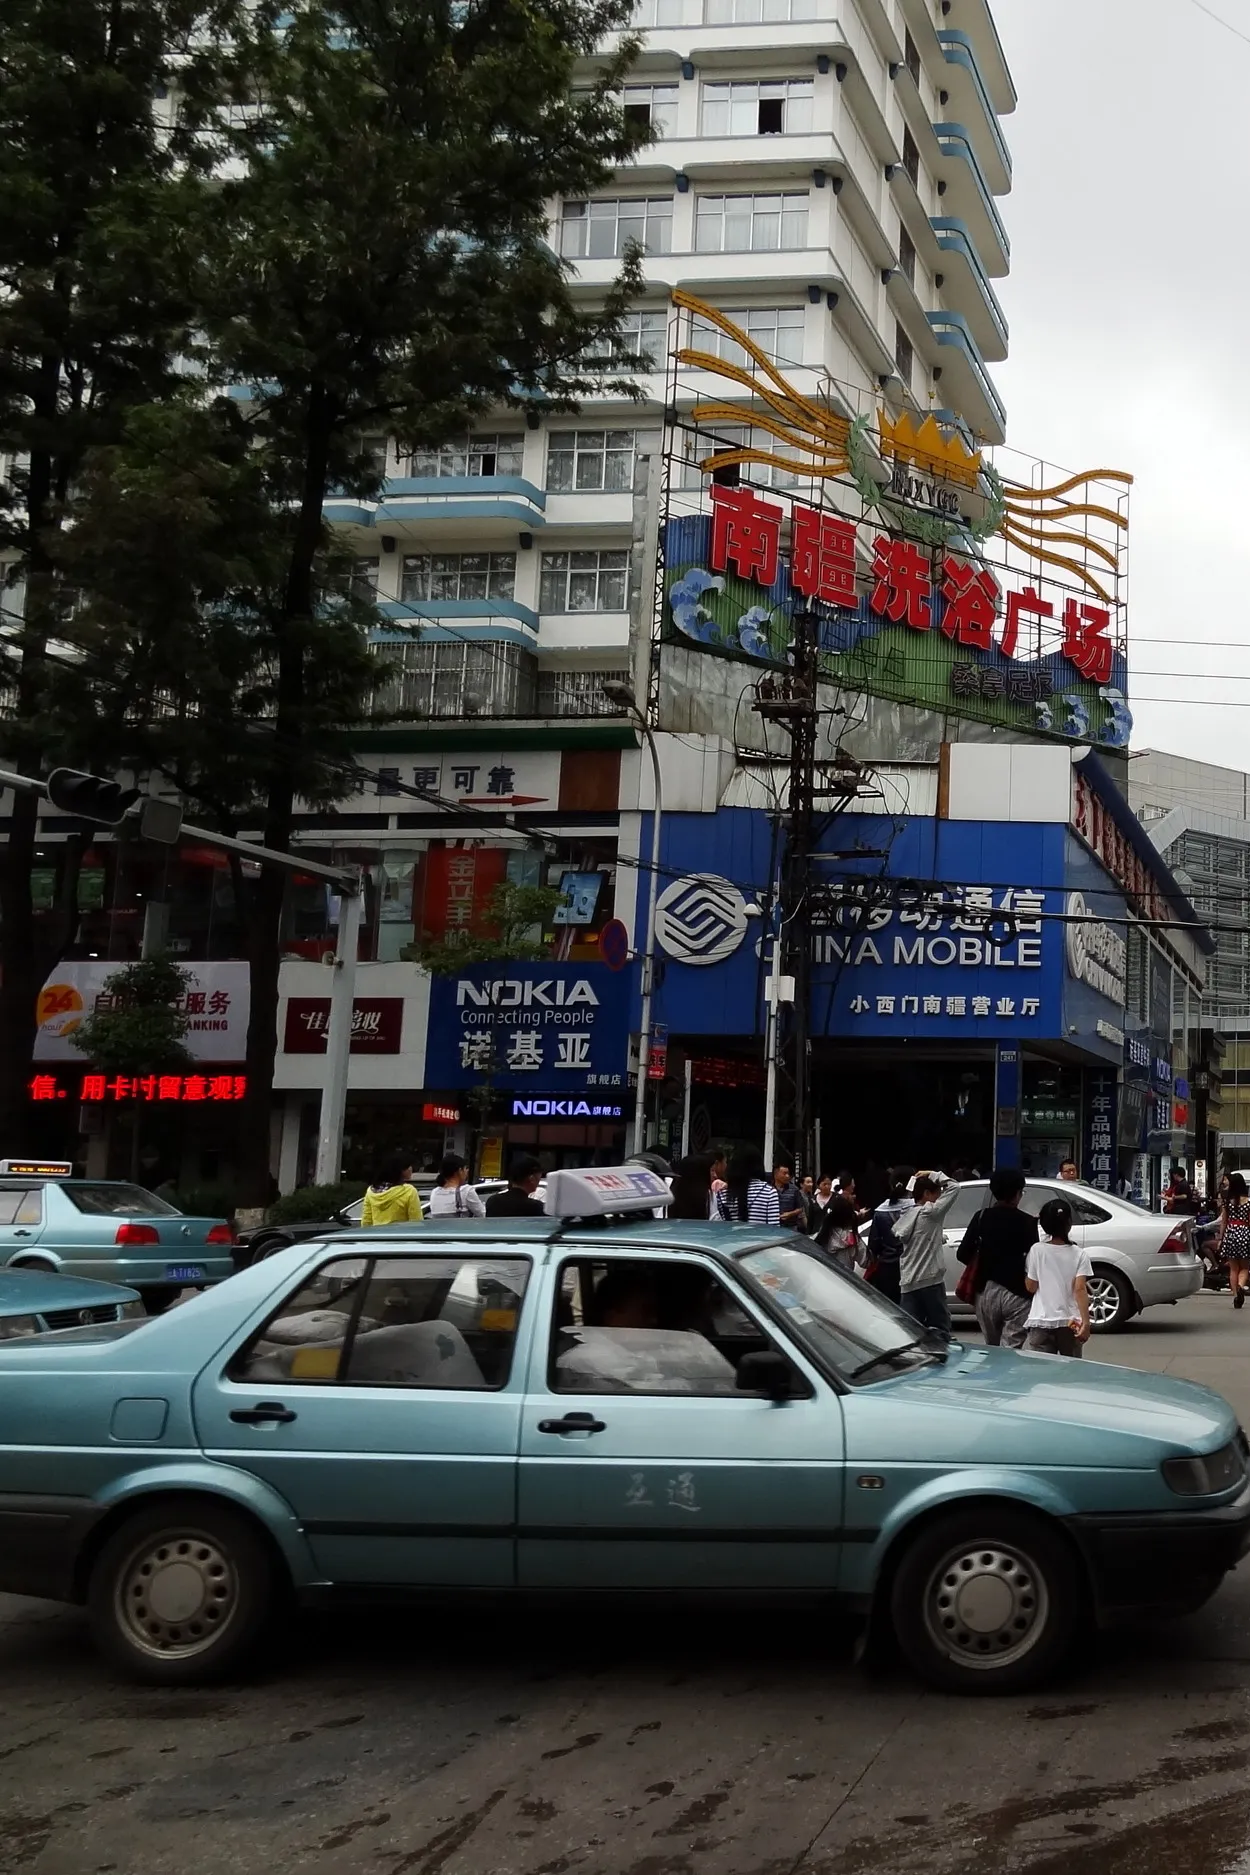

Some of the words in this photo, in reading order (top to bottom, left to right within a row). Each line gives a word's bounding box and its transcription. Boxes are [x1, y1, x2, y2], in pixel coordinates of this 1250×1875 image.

[709, 484, 1112, 683] 南疆洗浴广场
[893, 936, 1042, 967] MOBILE
[42, 990, 75, 1014] 24
[456, 980, 600, 1006] NOKIA
[461, 1009, 540, 1026] Connecting
[545, 1009, 594, 1026] People
[849, 994, 1041, 1018] 小西门南疆营业厅
[184, 1020, 228, 1031] ANKING
[459, 1030, 592, 1070] 诺基亚
[586, 1073, 621, 1085] 旗舰店
[513, 1100, 591, 1115] NOKIA
